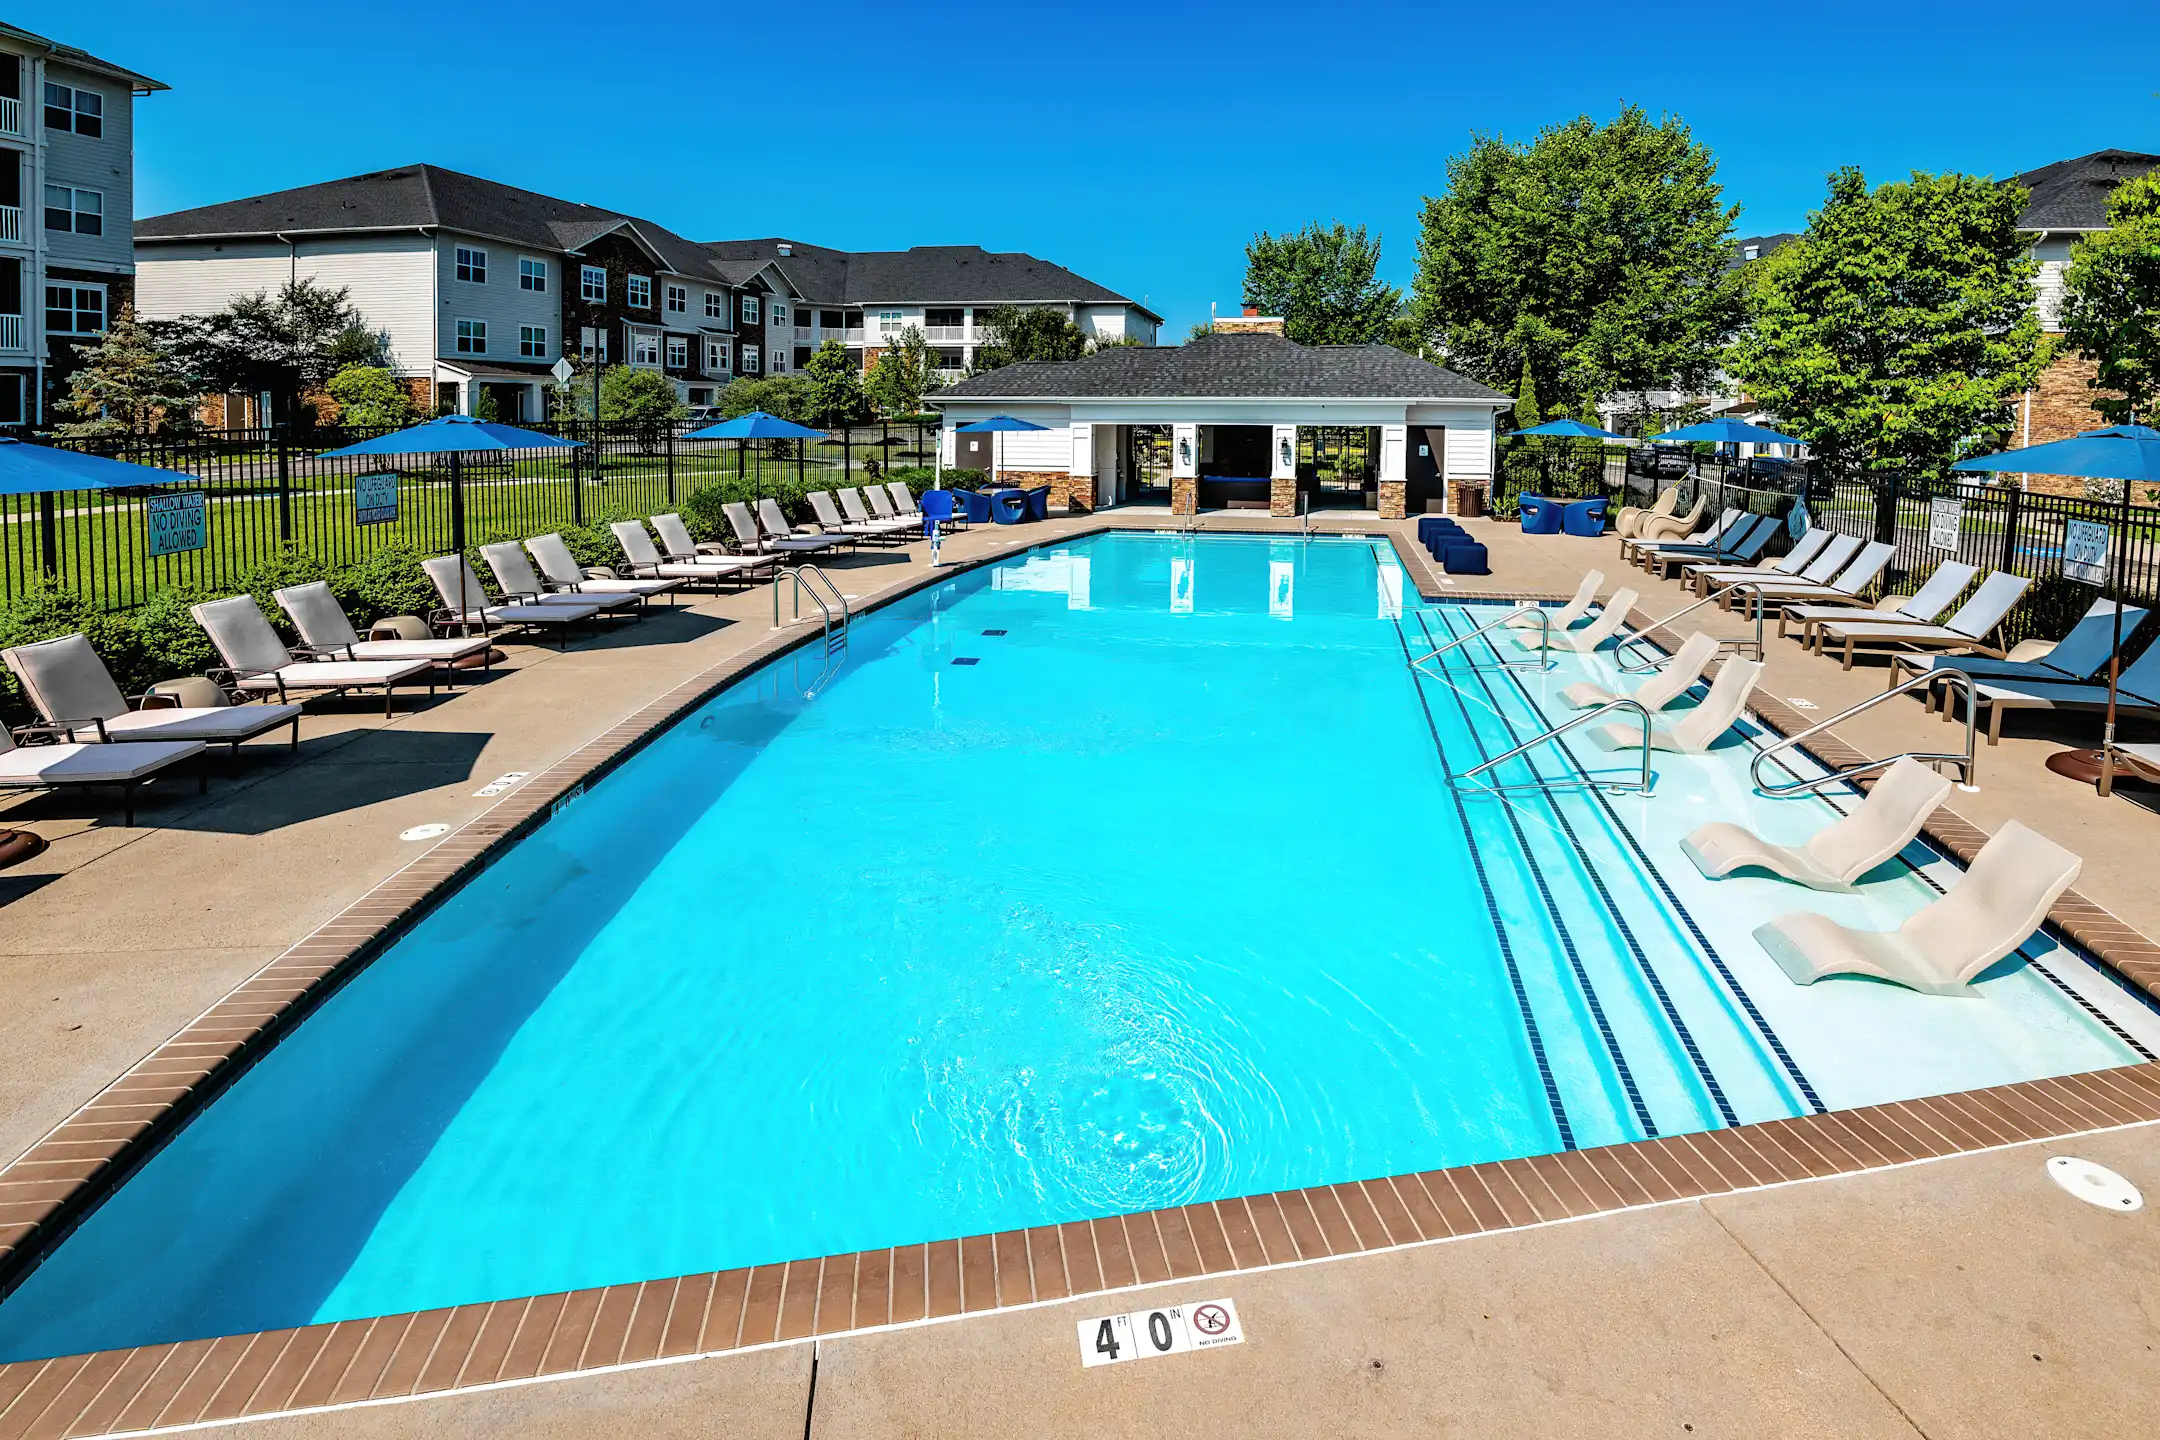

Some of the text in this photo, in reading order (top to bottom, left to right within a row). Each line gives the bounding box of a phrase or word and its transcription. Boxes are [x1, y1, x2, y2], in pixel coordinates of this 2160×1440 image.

[357, 475, 396, 492] NO LIFEGUARD
[150, 494, 203, 513] SHALLOW WATER
[366, 492, 388, 507] ON DUTY
[152, 508, 202, 532] NO DIVING
[158, 529, 197, 551] ALLOWED
[1096, 1308, 1182, 1360] 4 FT 0 IN
[1212, 1335, 1237, 1345] DIVING
